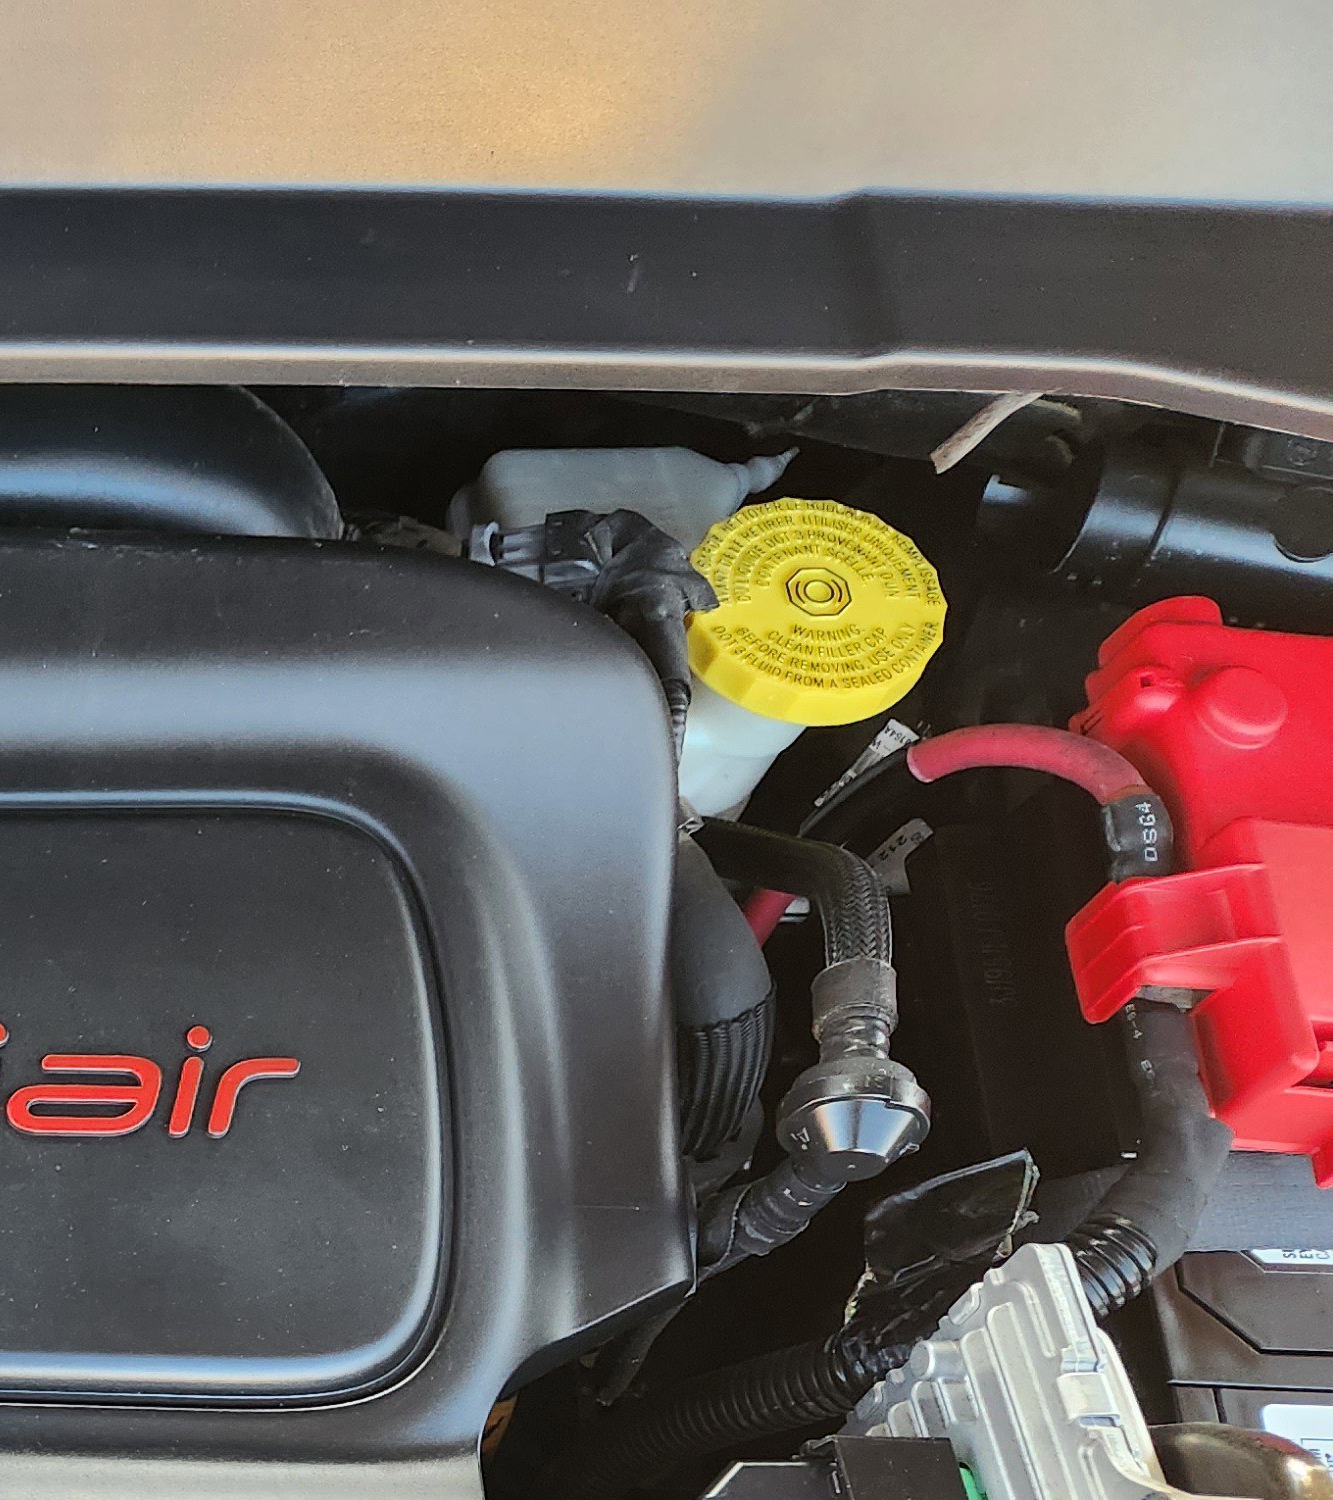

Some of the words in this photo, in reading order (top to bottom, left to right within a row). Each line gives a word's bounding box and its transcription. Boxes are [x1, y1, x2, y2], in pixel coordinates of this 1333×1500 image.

[712, 625, 738, 647] DOT
[744, 652, 782, 676] FLUID
[785, 671, 824, 688] FROM
[830, 679, 838, 689] A
[842, 670, 892, 689] SEALED
[891, 621, 939, 674] CONTAINER
[736, 626, 784, 663] BEFORE
[870, 650, 896, 666] USE
[890, 622, 916, 649] ONLY
[766, 630, 812, 655] CLEAN
[818, 641, 862, 657] FILLER
[865, 626, 887, 648] CAP
